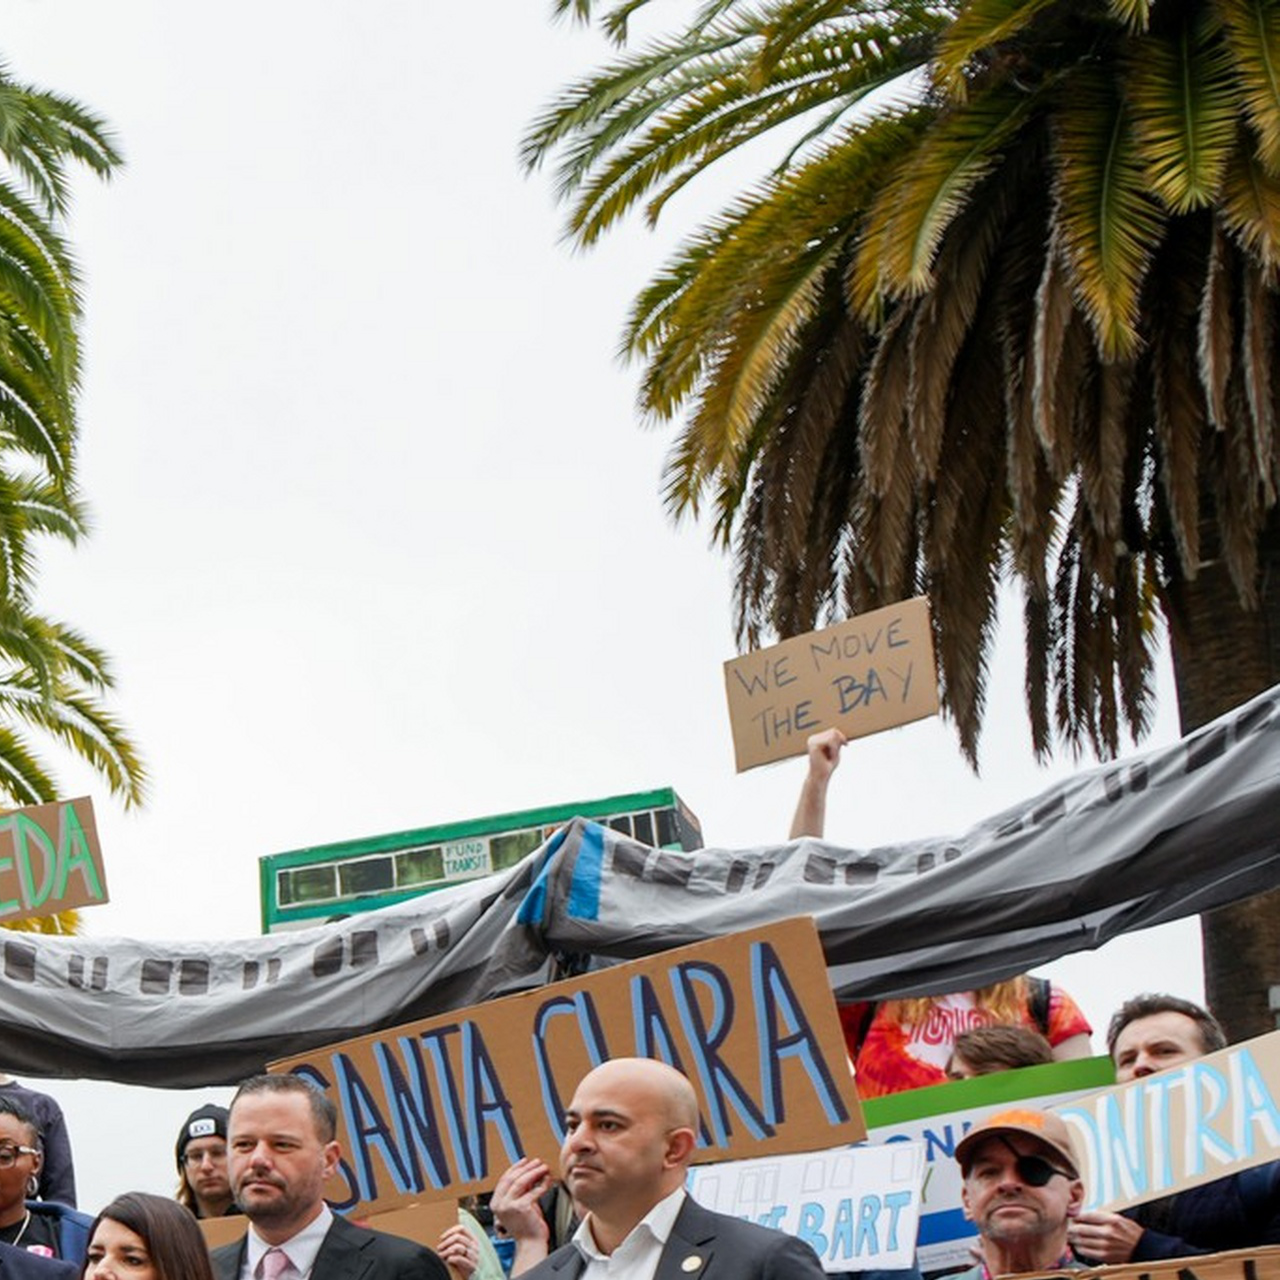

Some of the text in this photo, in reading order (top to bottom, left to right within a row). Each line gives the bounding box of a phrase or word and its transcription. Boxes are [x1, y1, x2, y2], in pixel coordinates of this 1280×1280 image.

[734, 618, 910, 697] WE MOVE
[752, 661, 913, 747] THE BAY
[446, 842, 484, 858] FUND
[796, 1190, 913, 1261] BART
